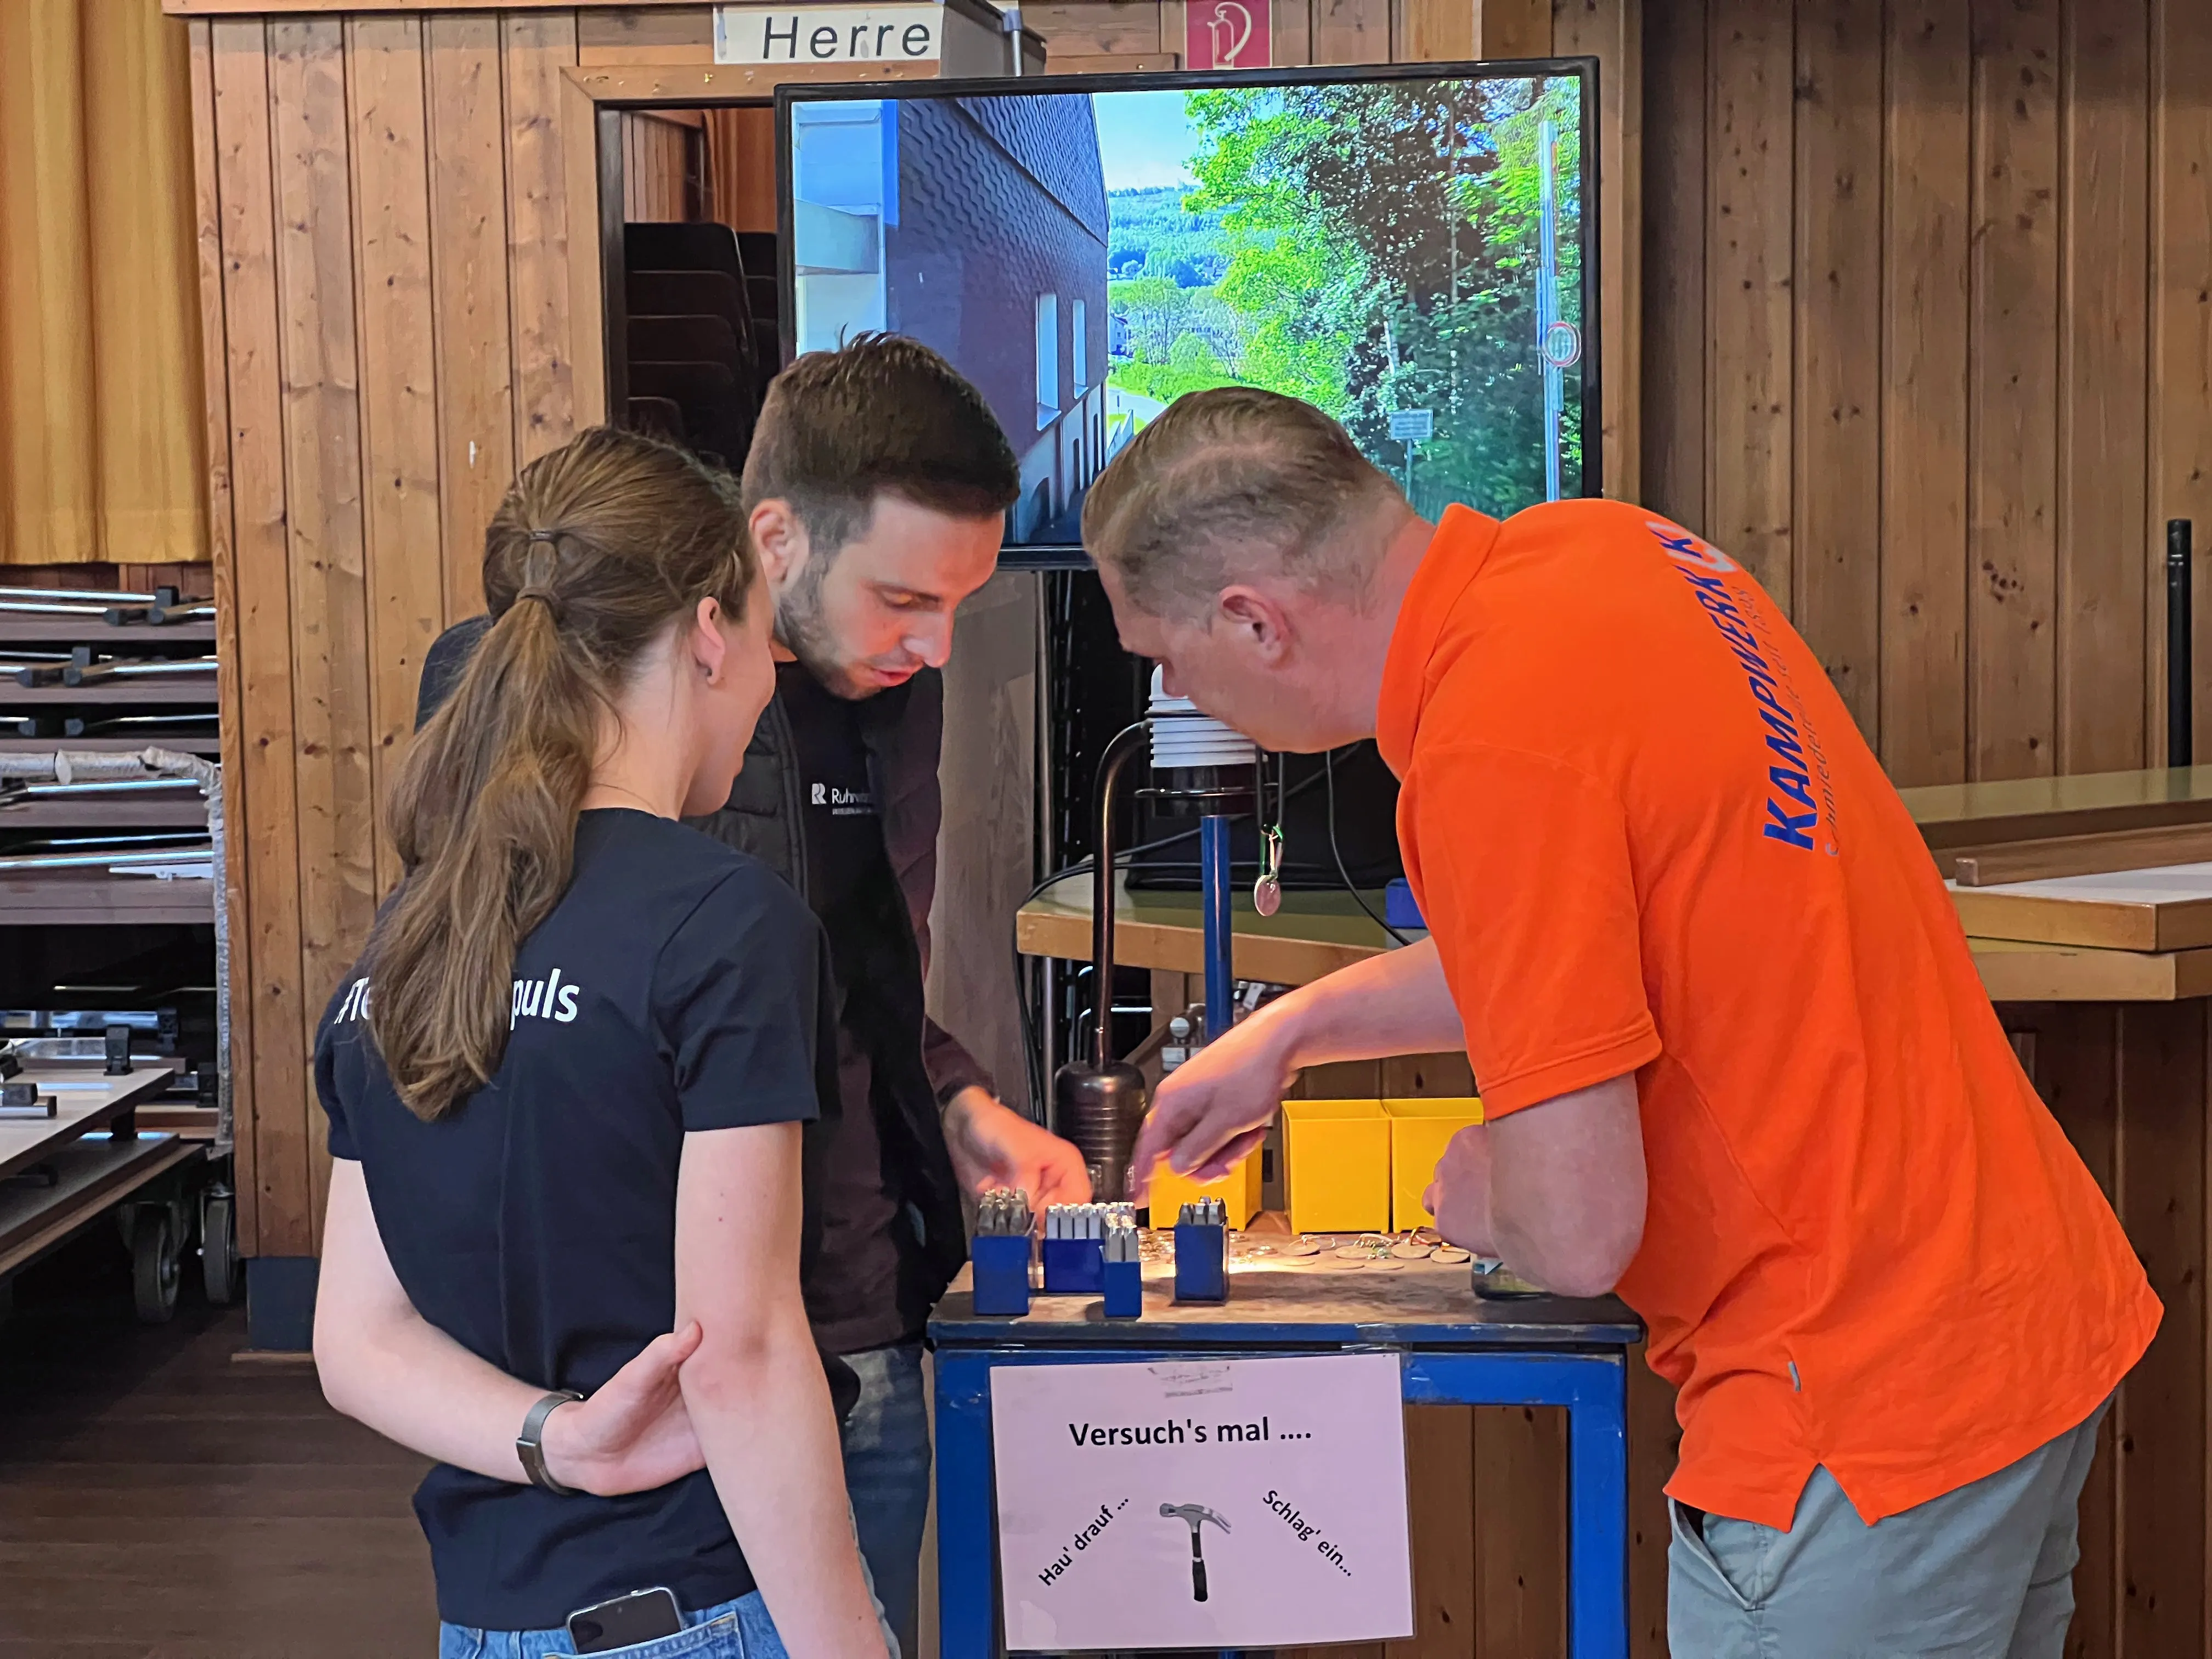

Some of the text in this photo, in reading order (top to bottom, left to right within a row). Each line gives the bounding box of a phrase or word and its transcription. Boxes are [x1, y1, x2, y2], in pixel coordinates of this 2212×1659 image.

[763, 15, 930, 59] Herre
[1069, 1419, 1207, 1447] Versuch's
[1217, 1416, 1269, 1442] mal
[1262, 1490, 1321, 1542] Schlag'
[1038, 1546, 1073, 1587] Hau'
[1074, 1504, 1114, 1551] drauf
